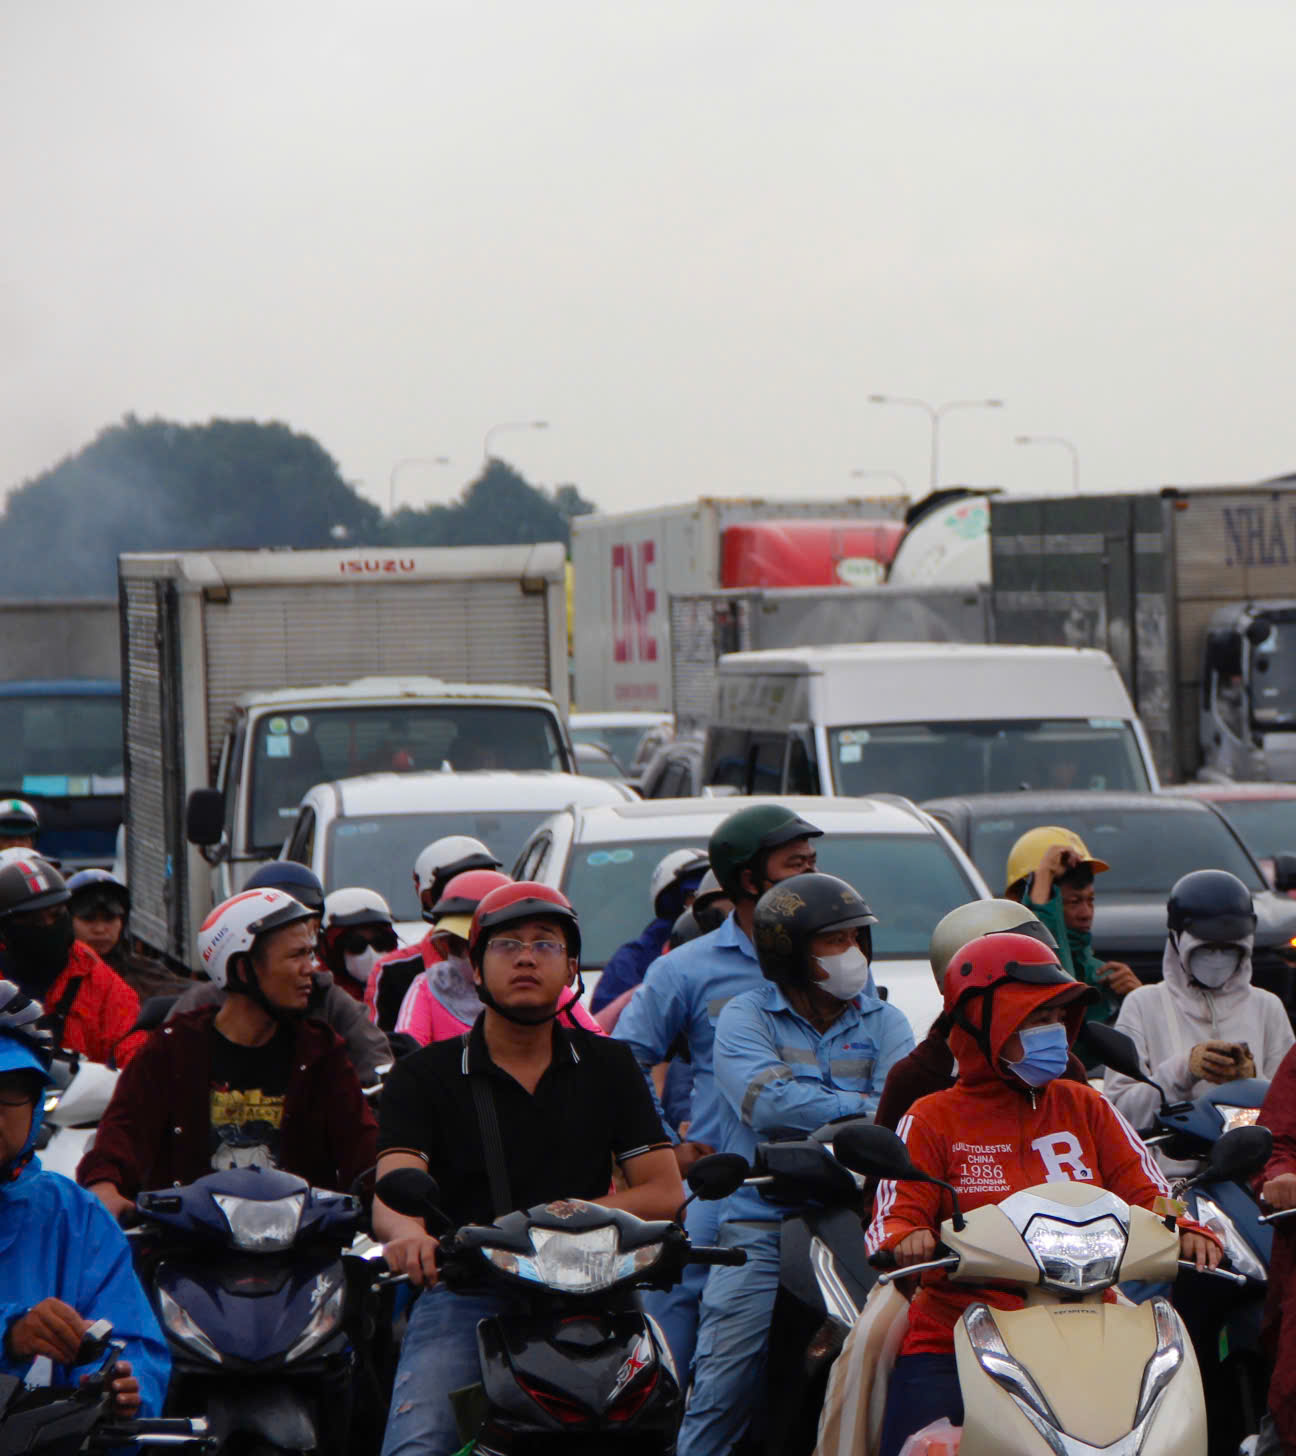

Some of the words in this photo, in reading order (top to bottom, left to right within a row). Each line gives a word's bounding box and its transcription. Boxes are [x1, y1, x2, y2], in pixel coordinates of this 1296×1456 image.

[339, 558, 415, 574] ISUZU
[610, 540, 657, 663] ONE
[967, 1155, 995, 1164] CHINA
[1031, 1131, 1094, 1184] R
[960, 1164, 1003, 1179] 1986
